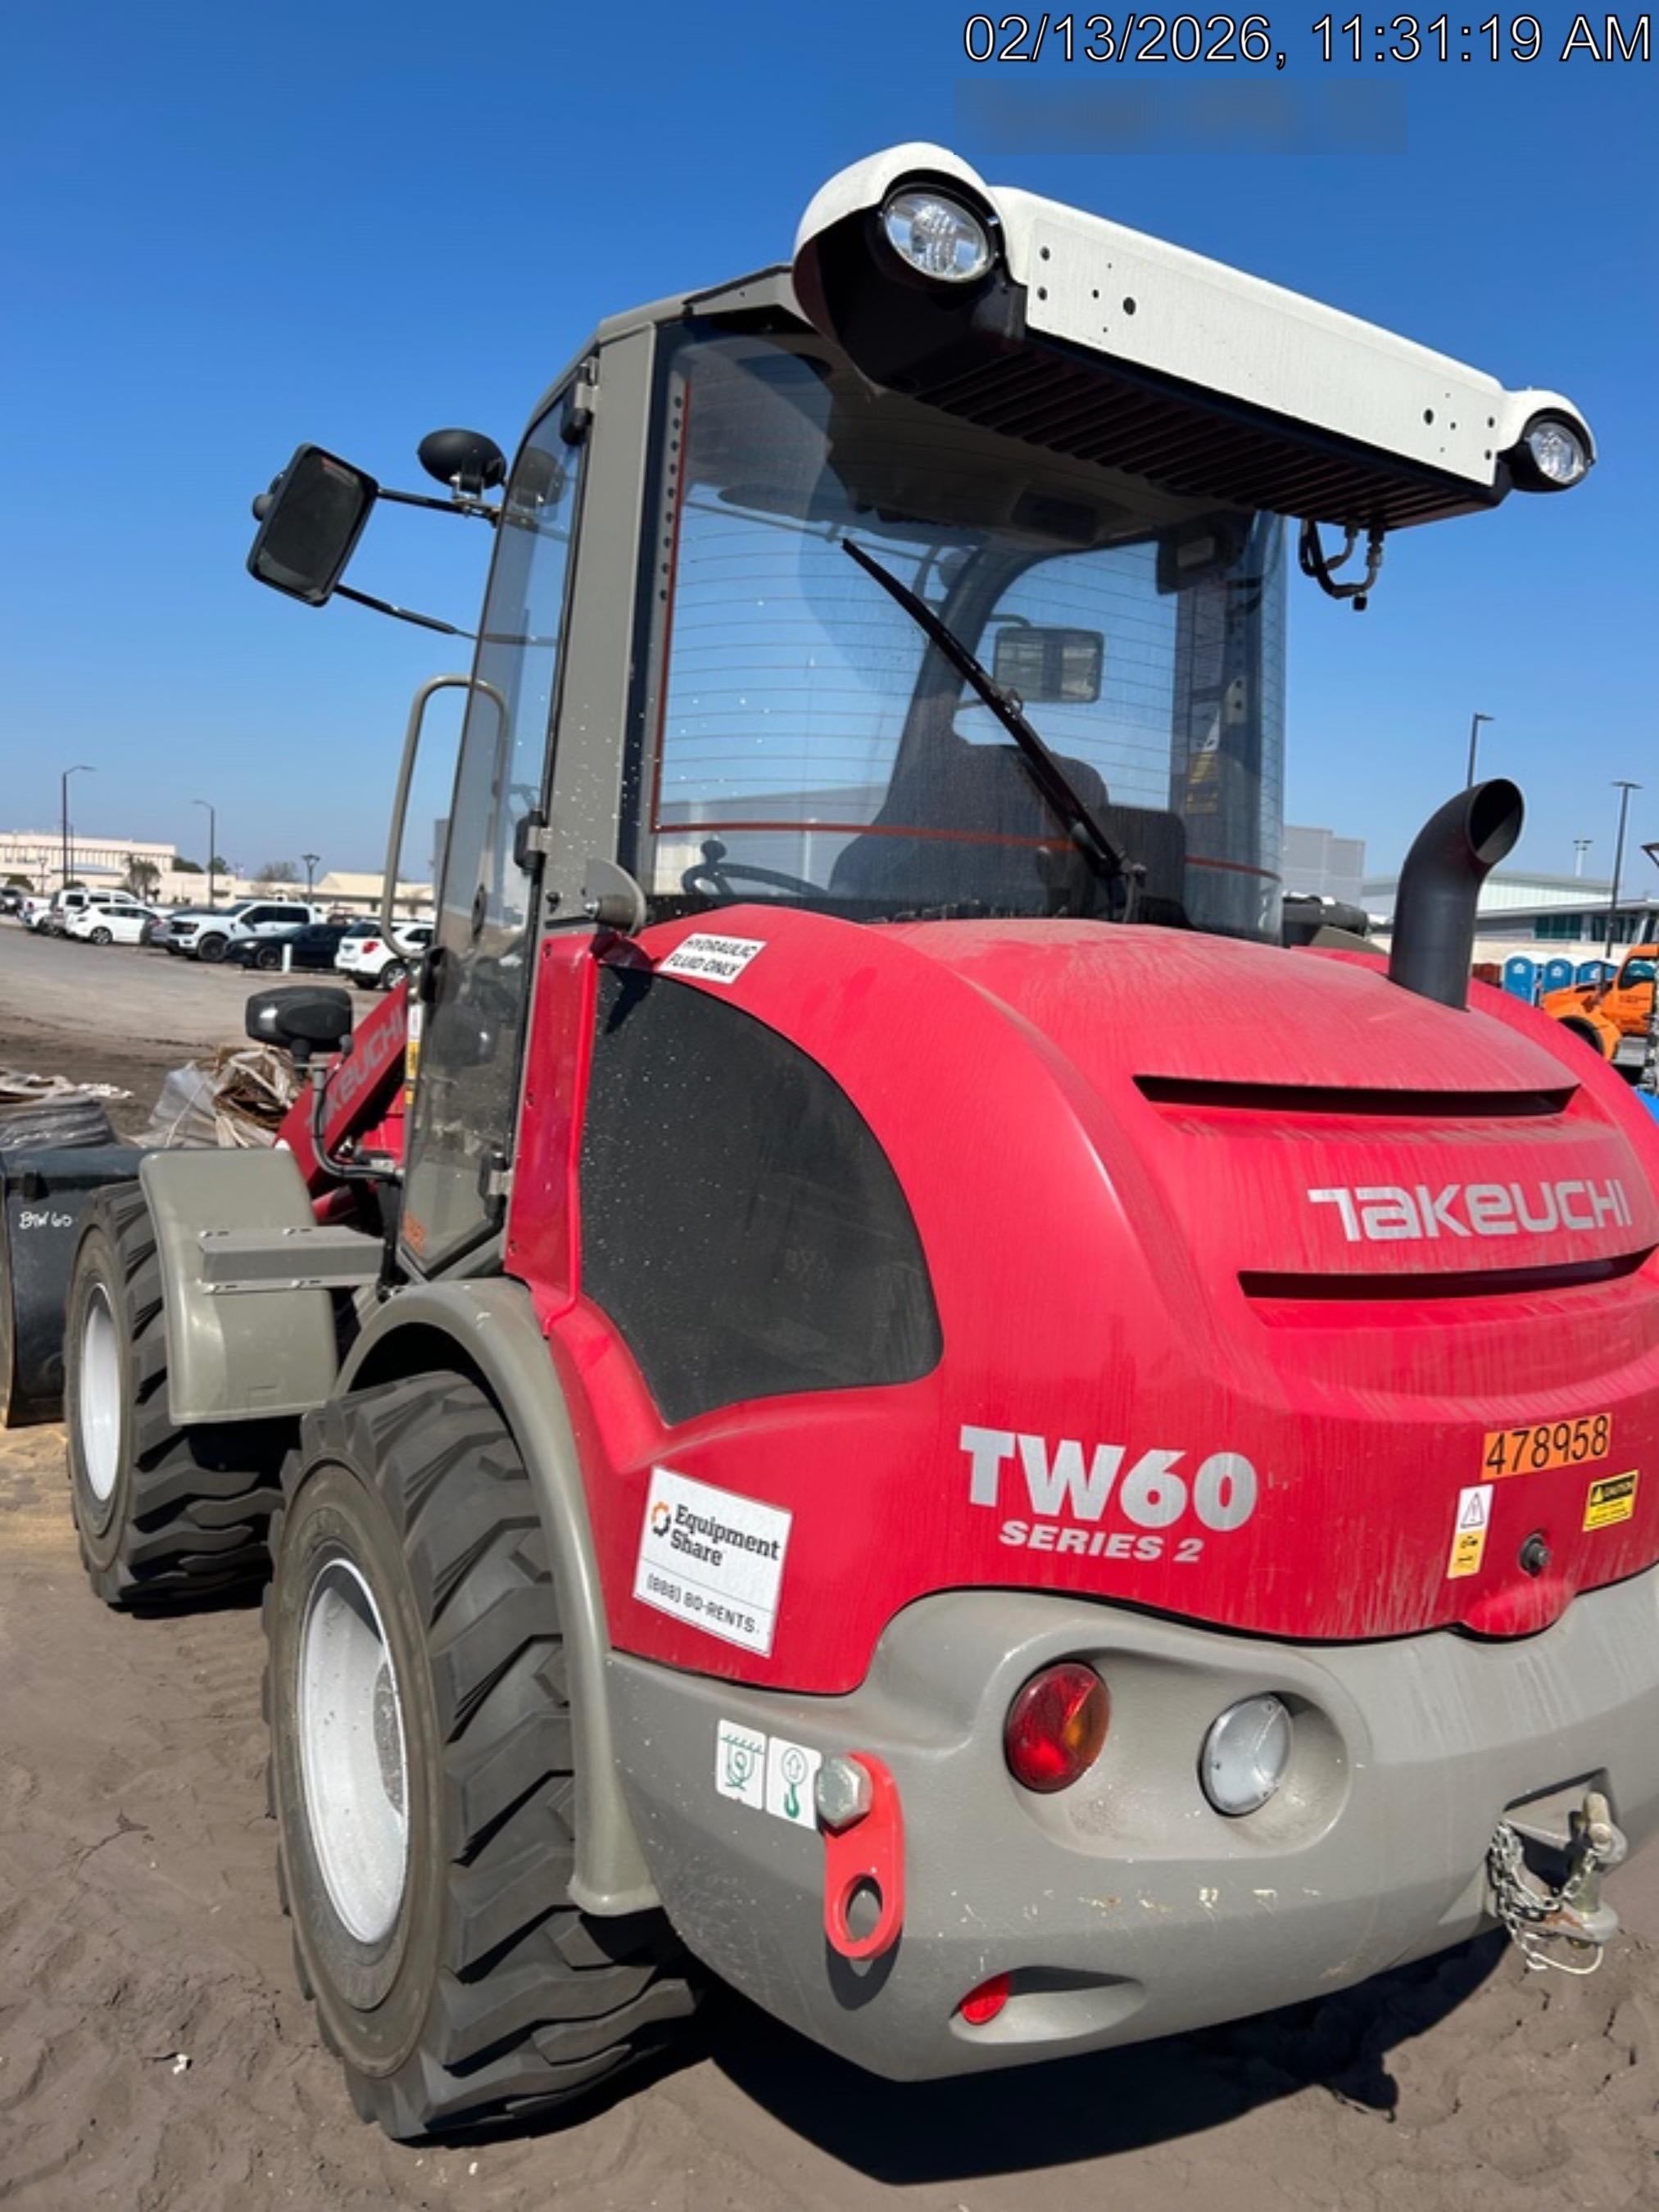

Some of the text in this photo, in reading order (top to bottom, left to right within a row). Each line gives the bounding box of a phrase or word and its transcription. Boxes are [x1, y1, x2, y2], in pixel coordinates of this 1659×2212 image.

[304, 1004, 404, 1128] KEUCHI
[1486, 1416, 1608, 1475] 478958
[960, 1425, 1258, 1531] TW60
[670, 1528, 723, 1566] Share
[675, 1503, 780, 1560] Equipment
[999, 1521, 1203, 1562] SERIES 2
